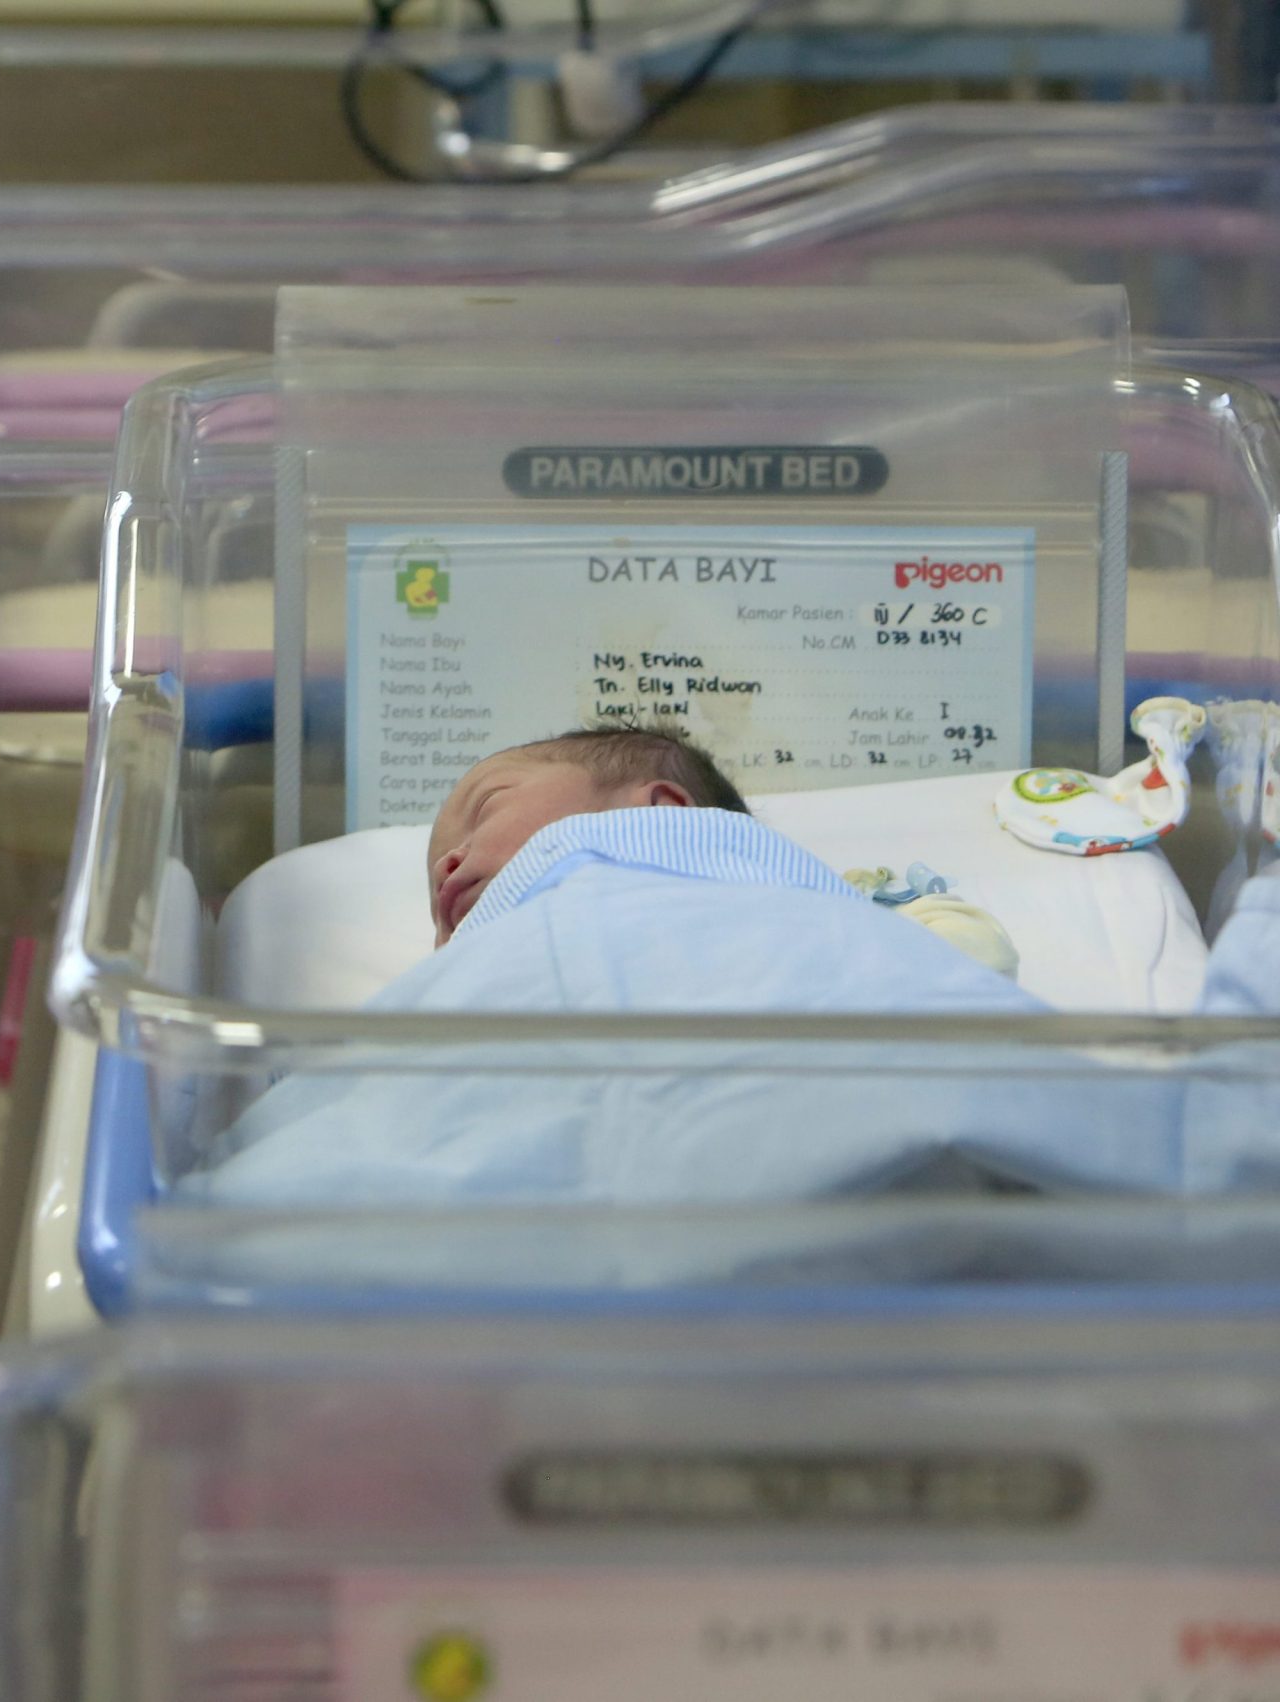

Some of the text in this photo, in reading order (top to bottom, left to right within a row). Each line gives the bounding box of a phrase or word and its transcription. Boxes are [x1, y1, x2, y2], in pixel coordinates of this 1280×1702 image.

[529, 455, 860, 489] PARAMOUNT BED
[588, 556, 778, 584] DATA BAYI
[893, 556, 1004, 589] pigeon
[736, 605, 844, 621] Kamar Pasien
[379, 632, 466, 652] Nama Bayi
[379, 656, 462, 672] Nama Ibu
[593, 651, 704, 672] Ny. Ervina
[379, 680, 473, 699] Nama Ayah
[593, 675, 763, 696] Tn. Elly Ridwan
[379, 703, 493, 720] Jenis Kelamin
[848, 706, 915, 722] Anak Ke
[381, 727, 492, 747] Tanggal Lahir
[848, 729, 930, 746] Jam Lahir
[379, 750, 481, 767] Berat Badan
[379, 774, 418, 791] Cara
[379, 798, 435, 814] Dokter
